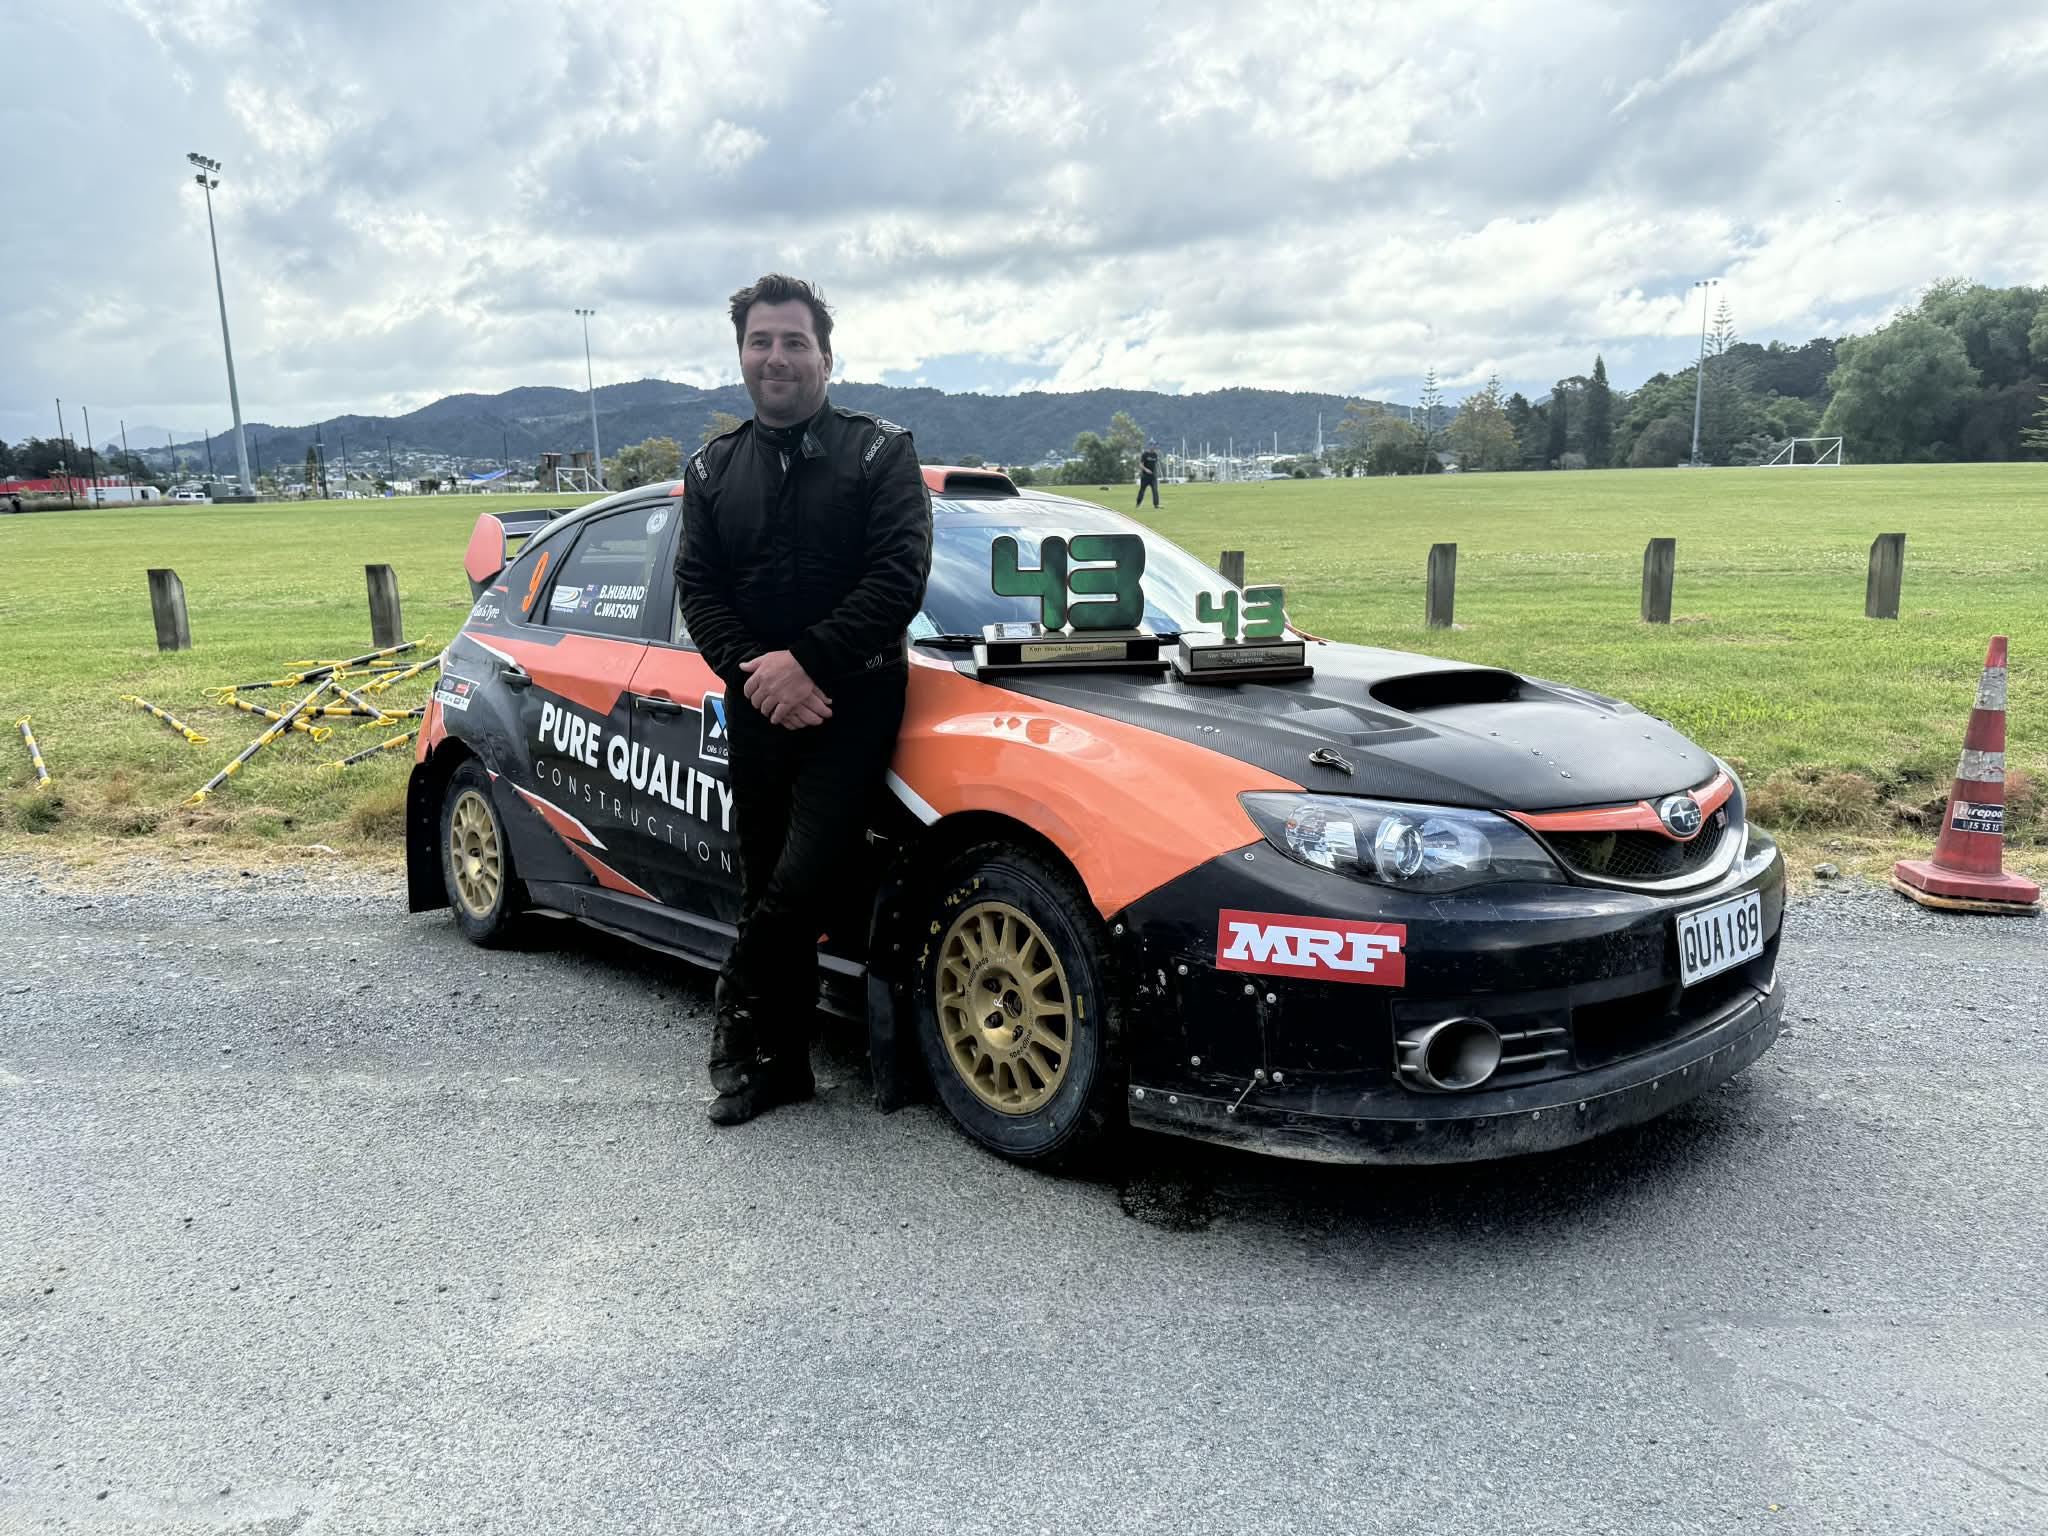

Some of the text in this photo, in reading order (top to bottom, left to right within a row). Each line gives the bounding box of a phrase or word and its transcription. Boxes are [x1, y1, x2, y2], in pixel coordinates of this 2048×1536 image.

[521, 551, 549, 613] 9
[594, 602, 640, 620] C.WATSON
[599, 584, 646, 601] B.HUBAND
[991, 533, 1146, 632] 43
[1195, 584, 1286, 640] 43
[539, 701, 733, 833] PURE QUALITY
[536, 760, 732, 874] CONSTRUCTION
[1222, 921, 1400, 973] MRF
[1684, 903, 1759, 974] QUA189
